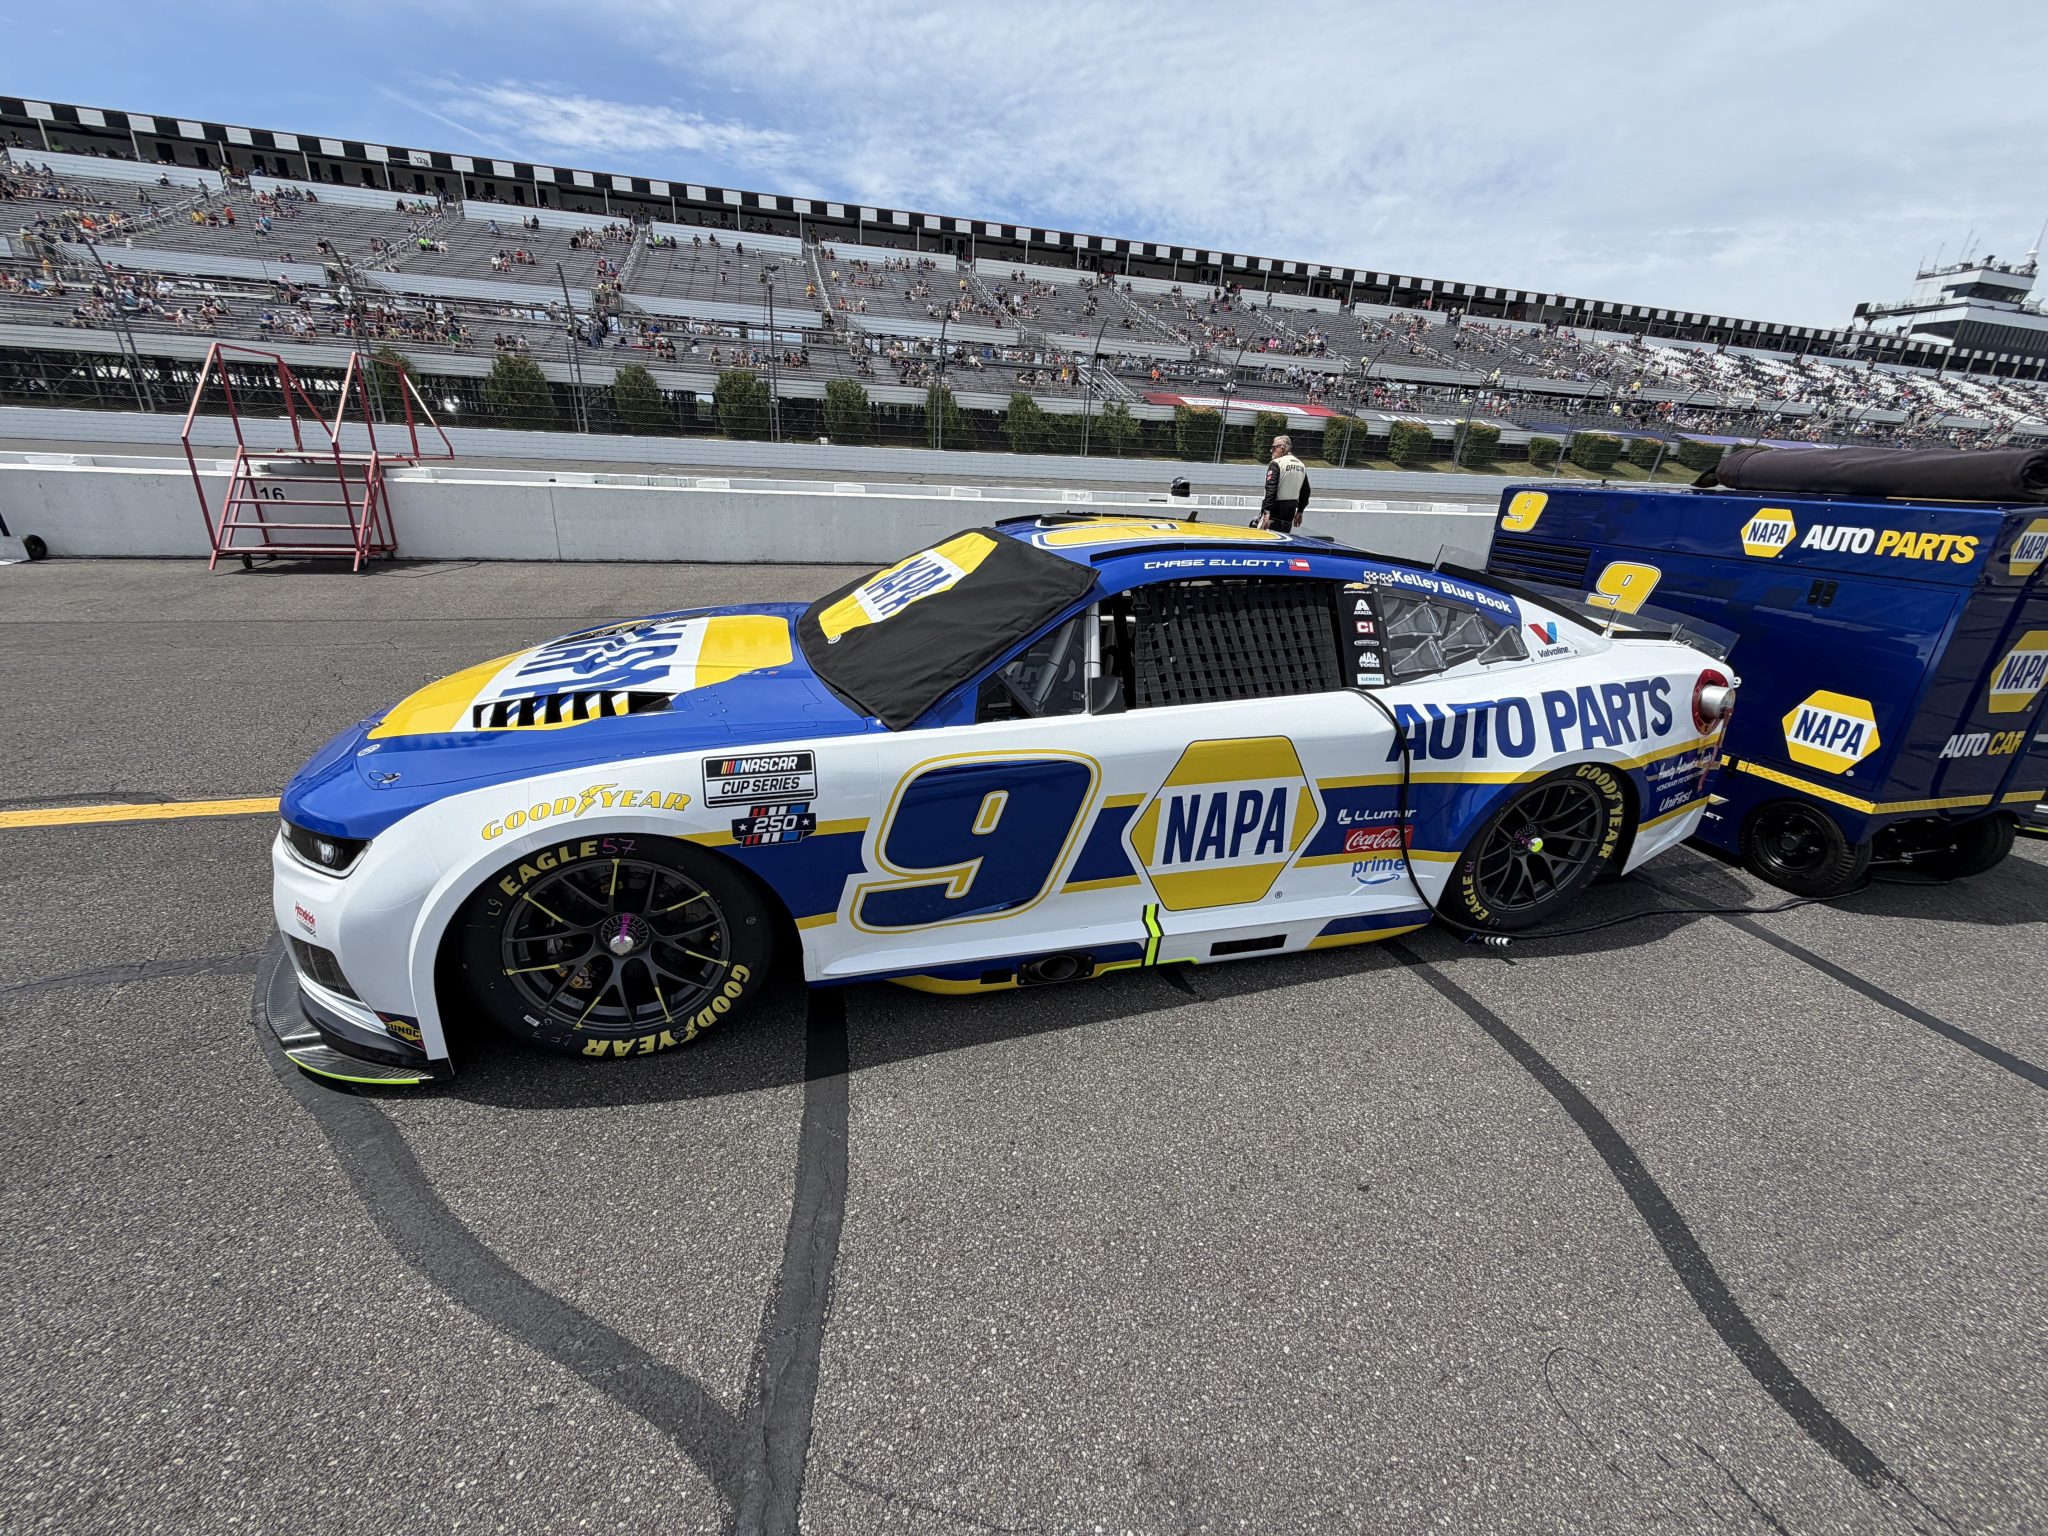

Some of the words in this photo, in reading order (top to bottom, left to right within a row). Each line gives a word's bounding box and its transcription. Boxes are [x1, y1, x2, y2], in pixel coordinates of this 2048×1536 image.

[1286, 465, 1304, 473] OFFIC
[260, 487, 285, 500] 16
[1501, 491, 1549, 532] 9
[1748, 521, 1788, 545] NAPA
[1800, 524, 1876, 554] AUTO
[1874, 530, 1980, 564] PARTS
[2014, 535, 2048, 560] NAPA
[1144, 558, 1205, 570] CHASE
[1208, 558, 1285, 568] ELLIOTT
[1392, 570, 1439, 593] Kelley
[1441, 580, 1476, 601] Blue
[1477, 591, 1512, 614] Book
[1585, 561, 1662, 615] 9
[1359, 651, 1380, 663] MAC
[1996, 655, 2048, 689] NAPA
[1386, 697, 1536, 762] AUTO
[1540, 676, 1674, 753] PARTS
[1793, 709, 1865, 756] NAPA
[1938, 733, 1990, 759] AUTO
[1987, 731, 2027, 756] CAR
[740, 756, 798, 773] NASCAR
[721, 780, 750, 795] CUP
[752, 776, 801, 792] SERIES
[752, 815, 798, 833] 250
[1161, 787, 1290, 865] NAPA
[602, 837, 637, 855] 57
[850, 749, 1101, 934] 9
[498, 839, 598, 897] EAGLE
[1351, 855, 1407, 877] prime
[1462, 874, 1490, 921] EAGLE
[387, 1023, 423, 1038] SUNOC
